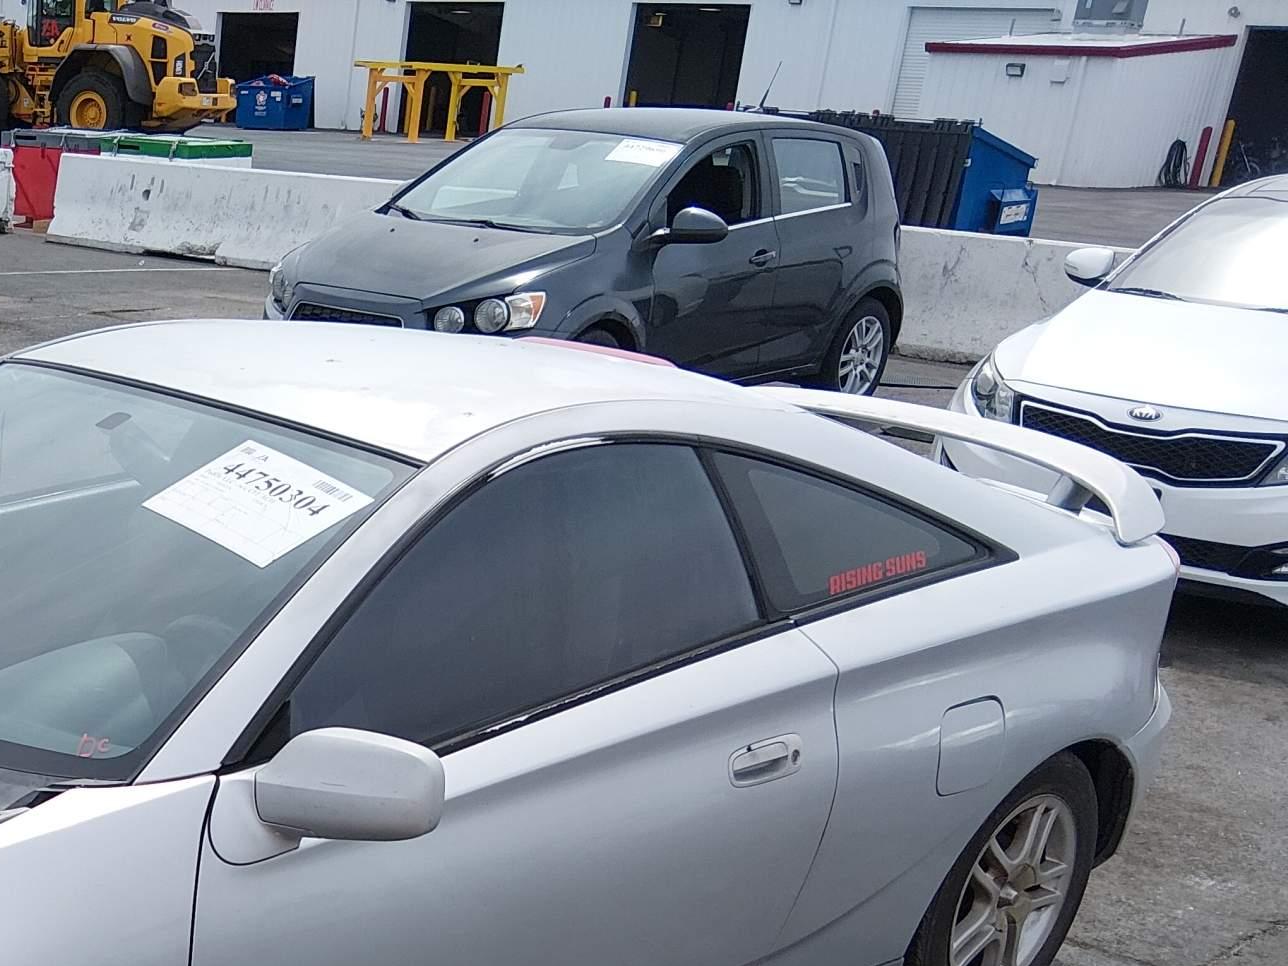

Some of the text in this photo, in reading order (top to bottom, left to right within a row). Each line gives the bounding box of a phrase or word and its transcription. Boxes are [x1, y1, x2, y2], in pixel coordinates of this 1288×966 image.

[223, 462, 330, 516] 44750304
[829, 551, 926, 595] RISING SUNS
